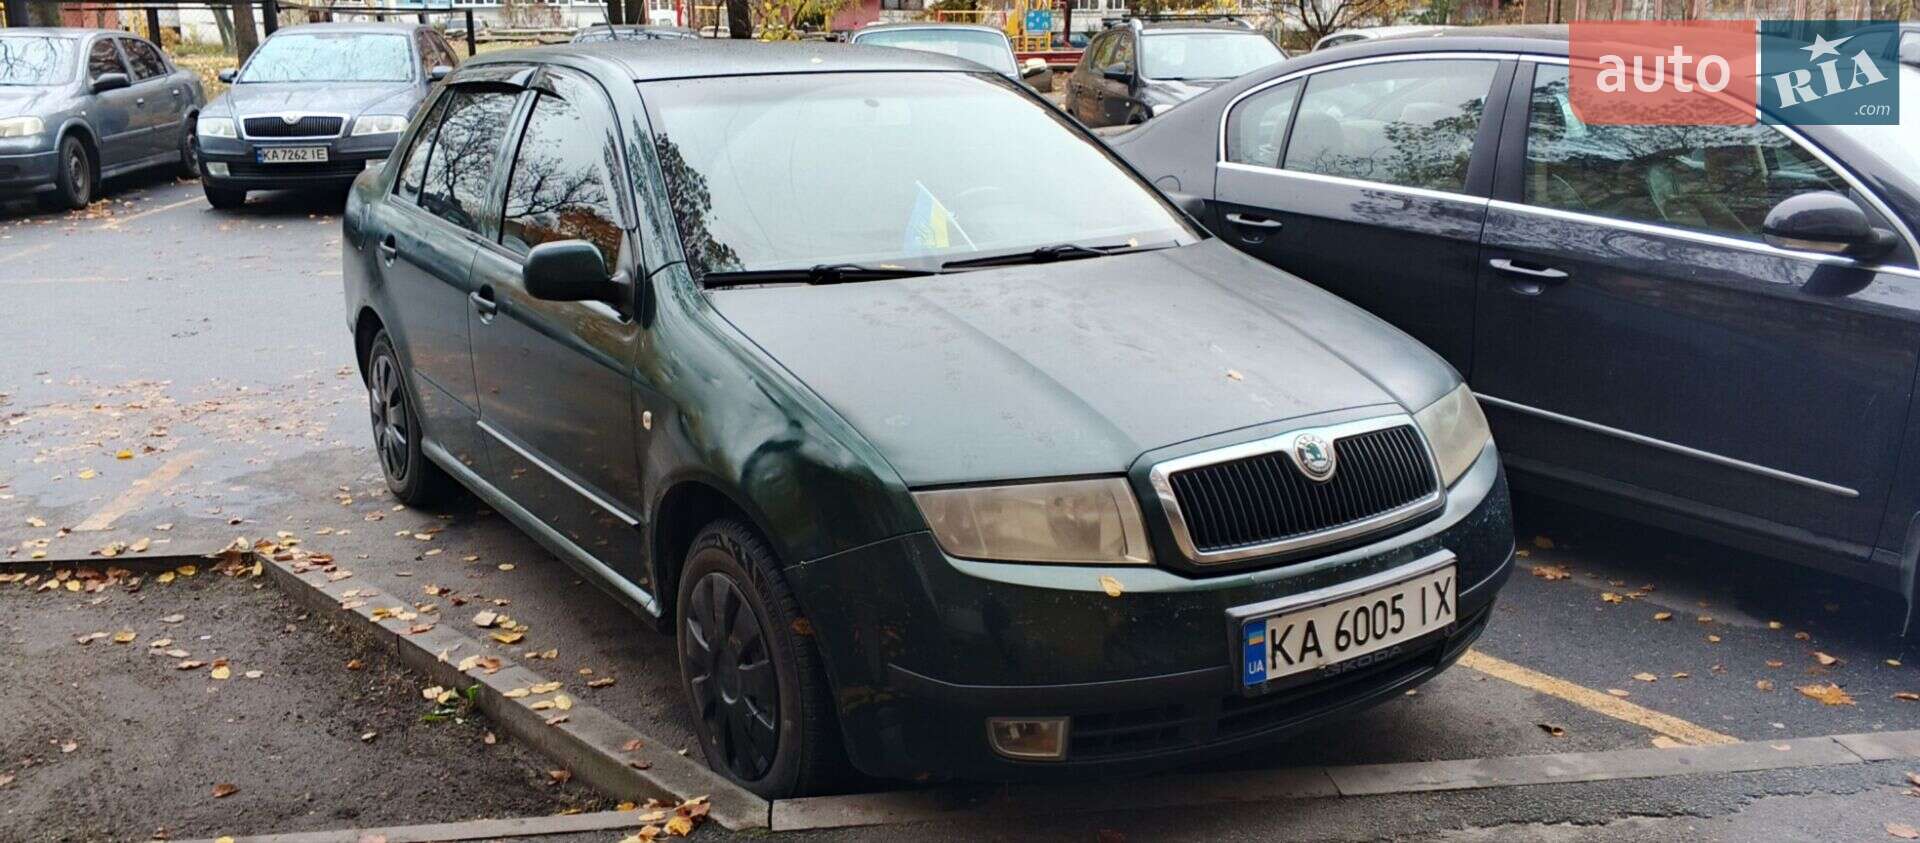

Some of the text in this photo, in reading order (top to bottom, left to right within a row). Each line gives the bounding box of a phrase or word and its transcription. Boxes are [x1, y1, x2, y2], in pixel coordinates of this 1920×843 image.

[263, 149, 279, 160] KA
[281, 148, 307, 160] 7262
[1270, 619, 1324, 670] KA
[1334, 593, 1406, 652] 6005
[1249, 664, 1265, 674] UA
